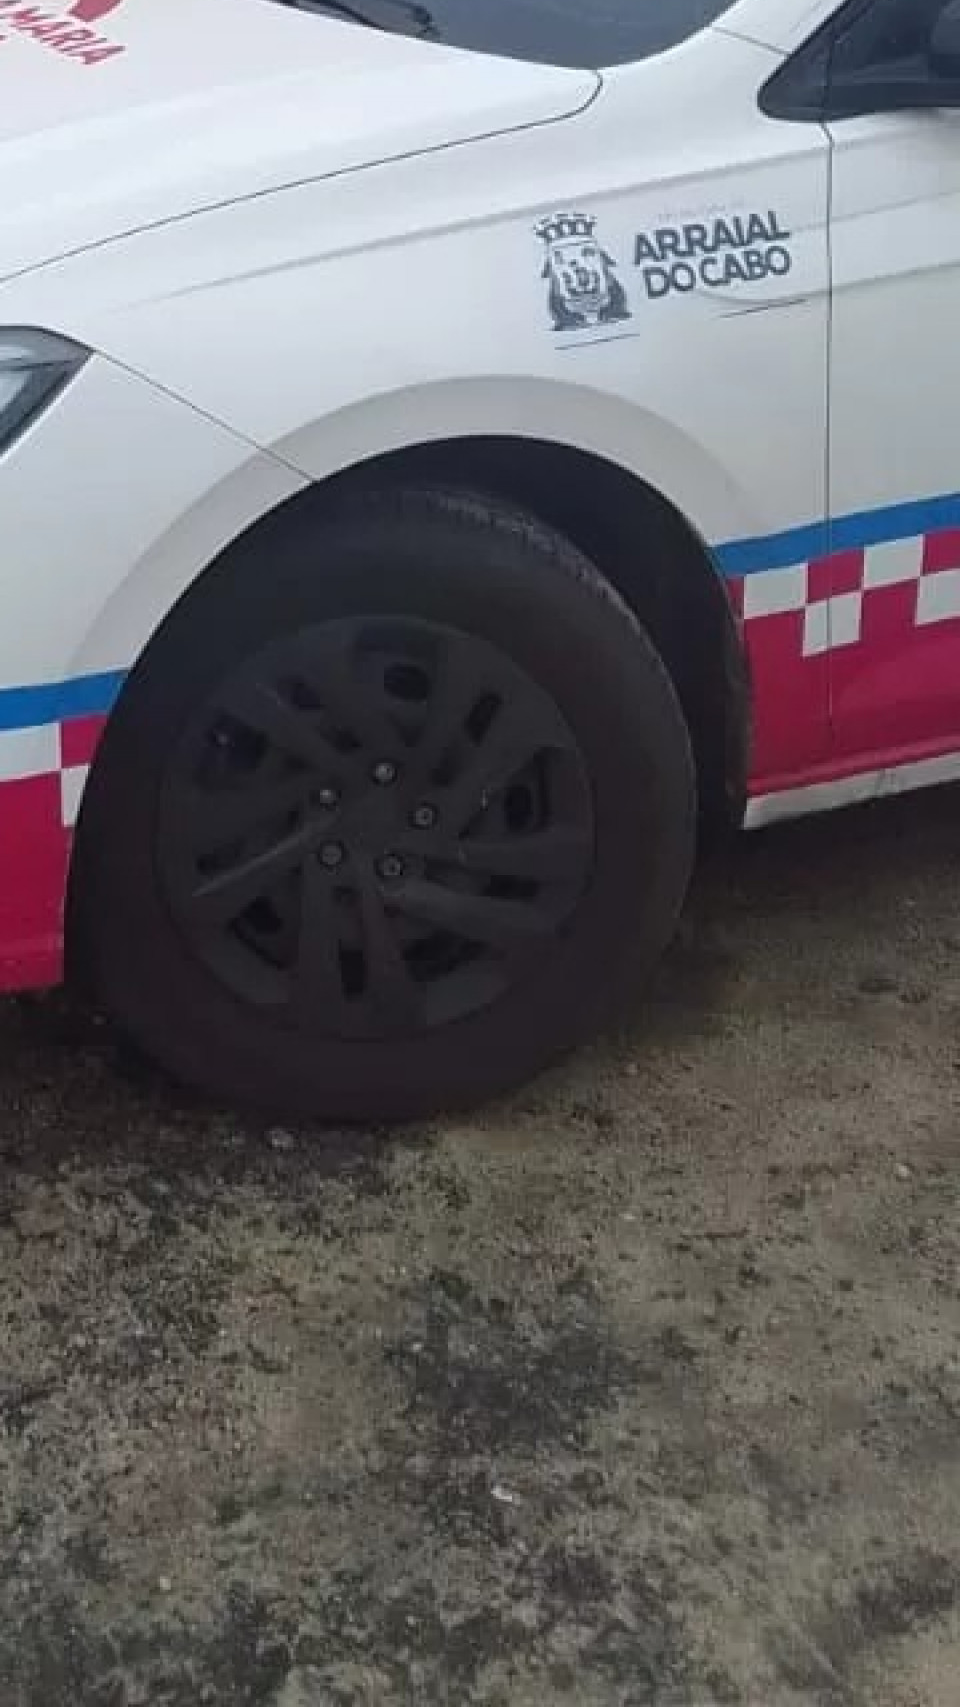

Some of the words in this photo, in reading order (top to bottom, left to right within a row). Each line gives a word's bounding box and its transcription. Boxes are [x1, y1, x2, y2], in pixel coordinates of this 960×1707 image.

[634, 210, 791, 264] ARRAIAL
[642, 262, 697, 299] DO
[699, 245, 791, 286] CABO
